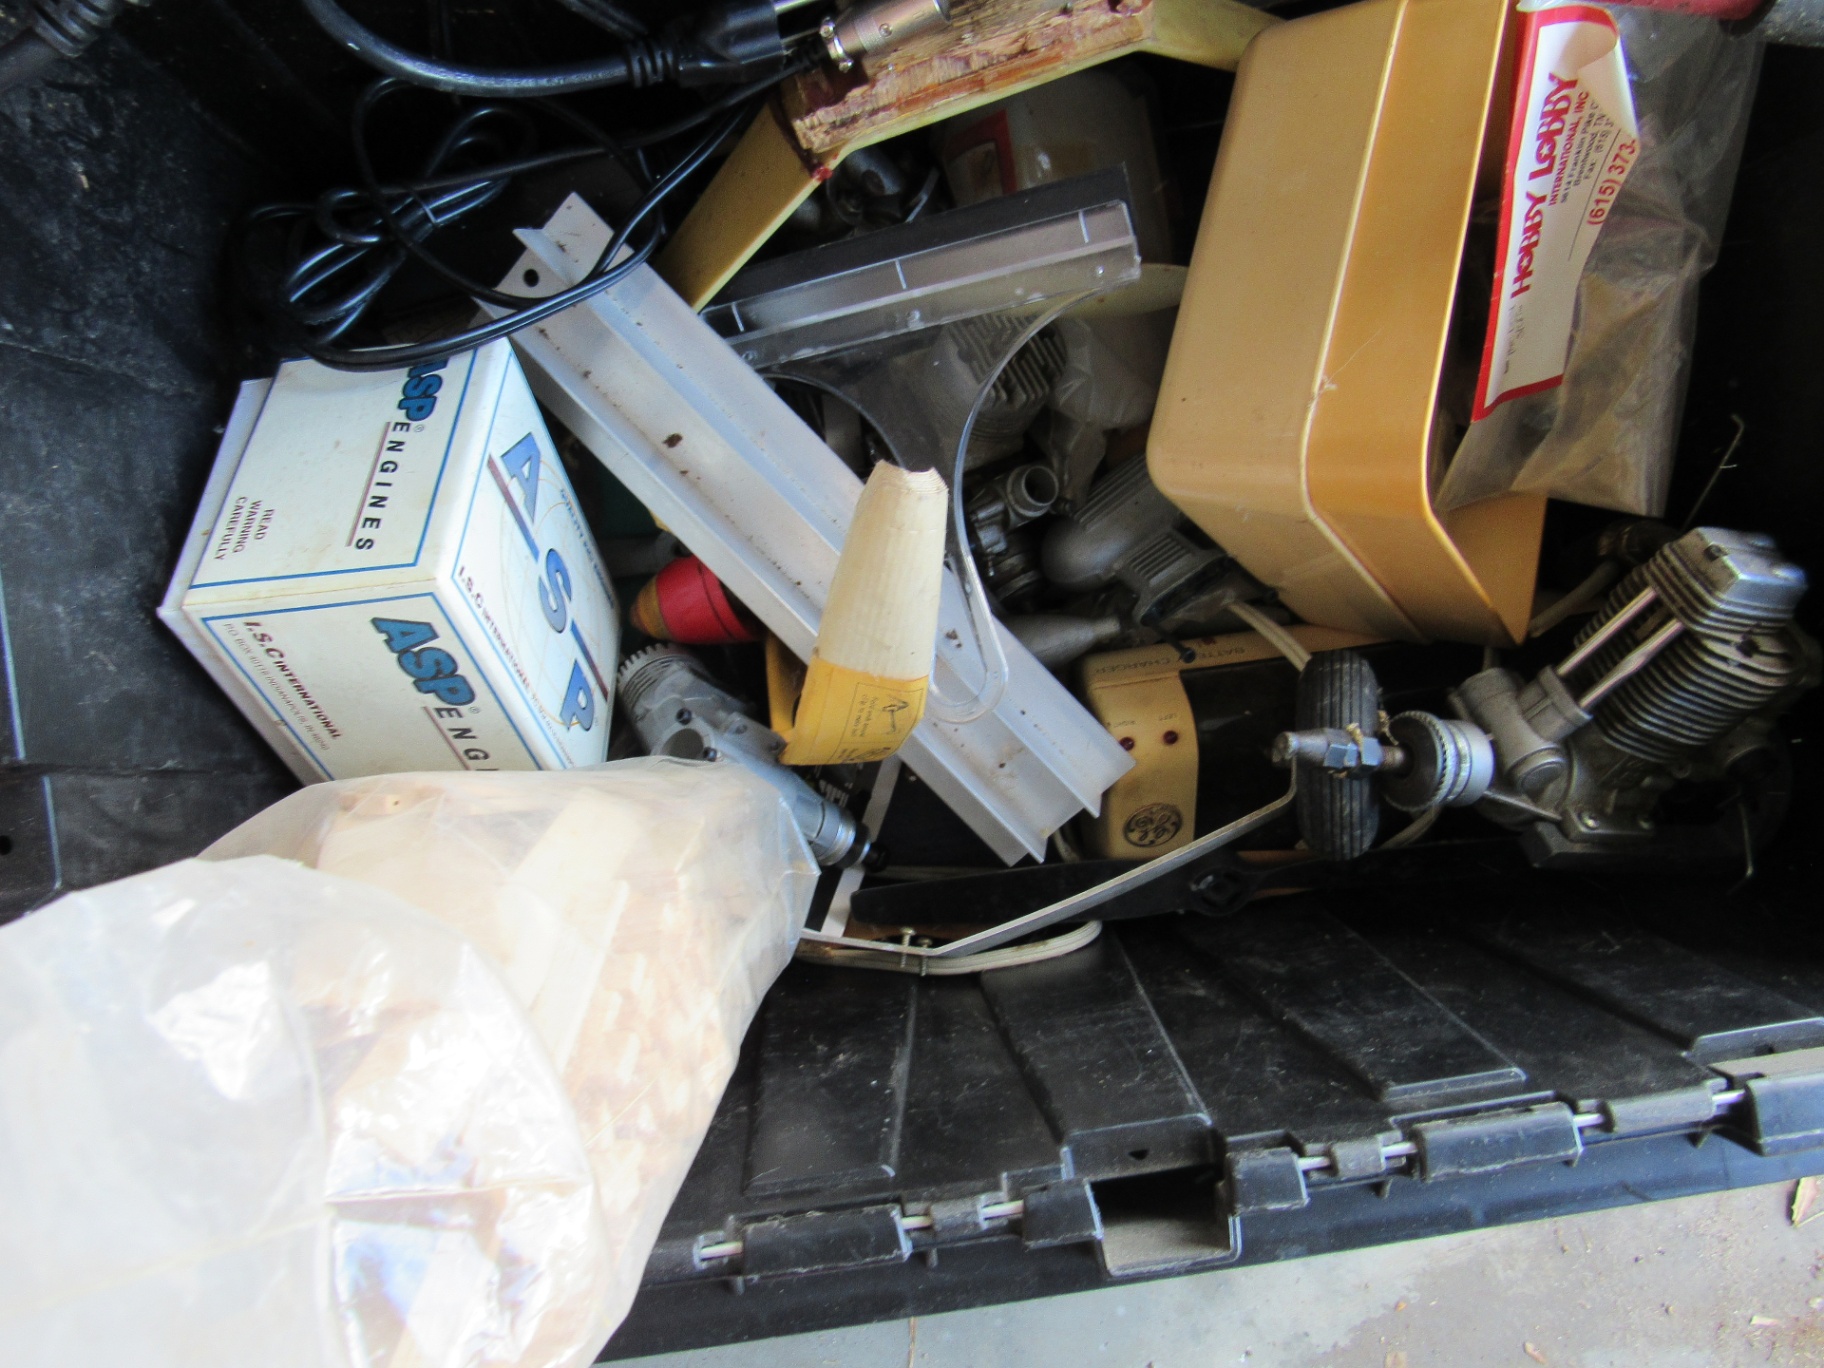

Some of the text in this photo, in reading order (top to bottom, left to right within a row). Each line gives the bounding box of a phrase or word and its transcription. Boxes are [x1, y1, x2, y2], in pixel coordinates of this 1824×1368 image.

[1528, 72, 1579, 181] LOBBY
[1587, 178, 1623, 225] (615)
[1510, 191, 1548, 299] HOBBY
[254, 509, 276, 540] READ
[355, 420, 412, 550] ENGINES
[214, 496, 248, 561] CAREFULLY
[232, 500, 263, 554] WARNING
[272, 660, 342, 740] INTERNATIONAL
[370, 616, 476, 707] ASP
